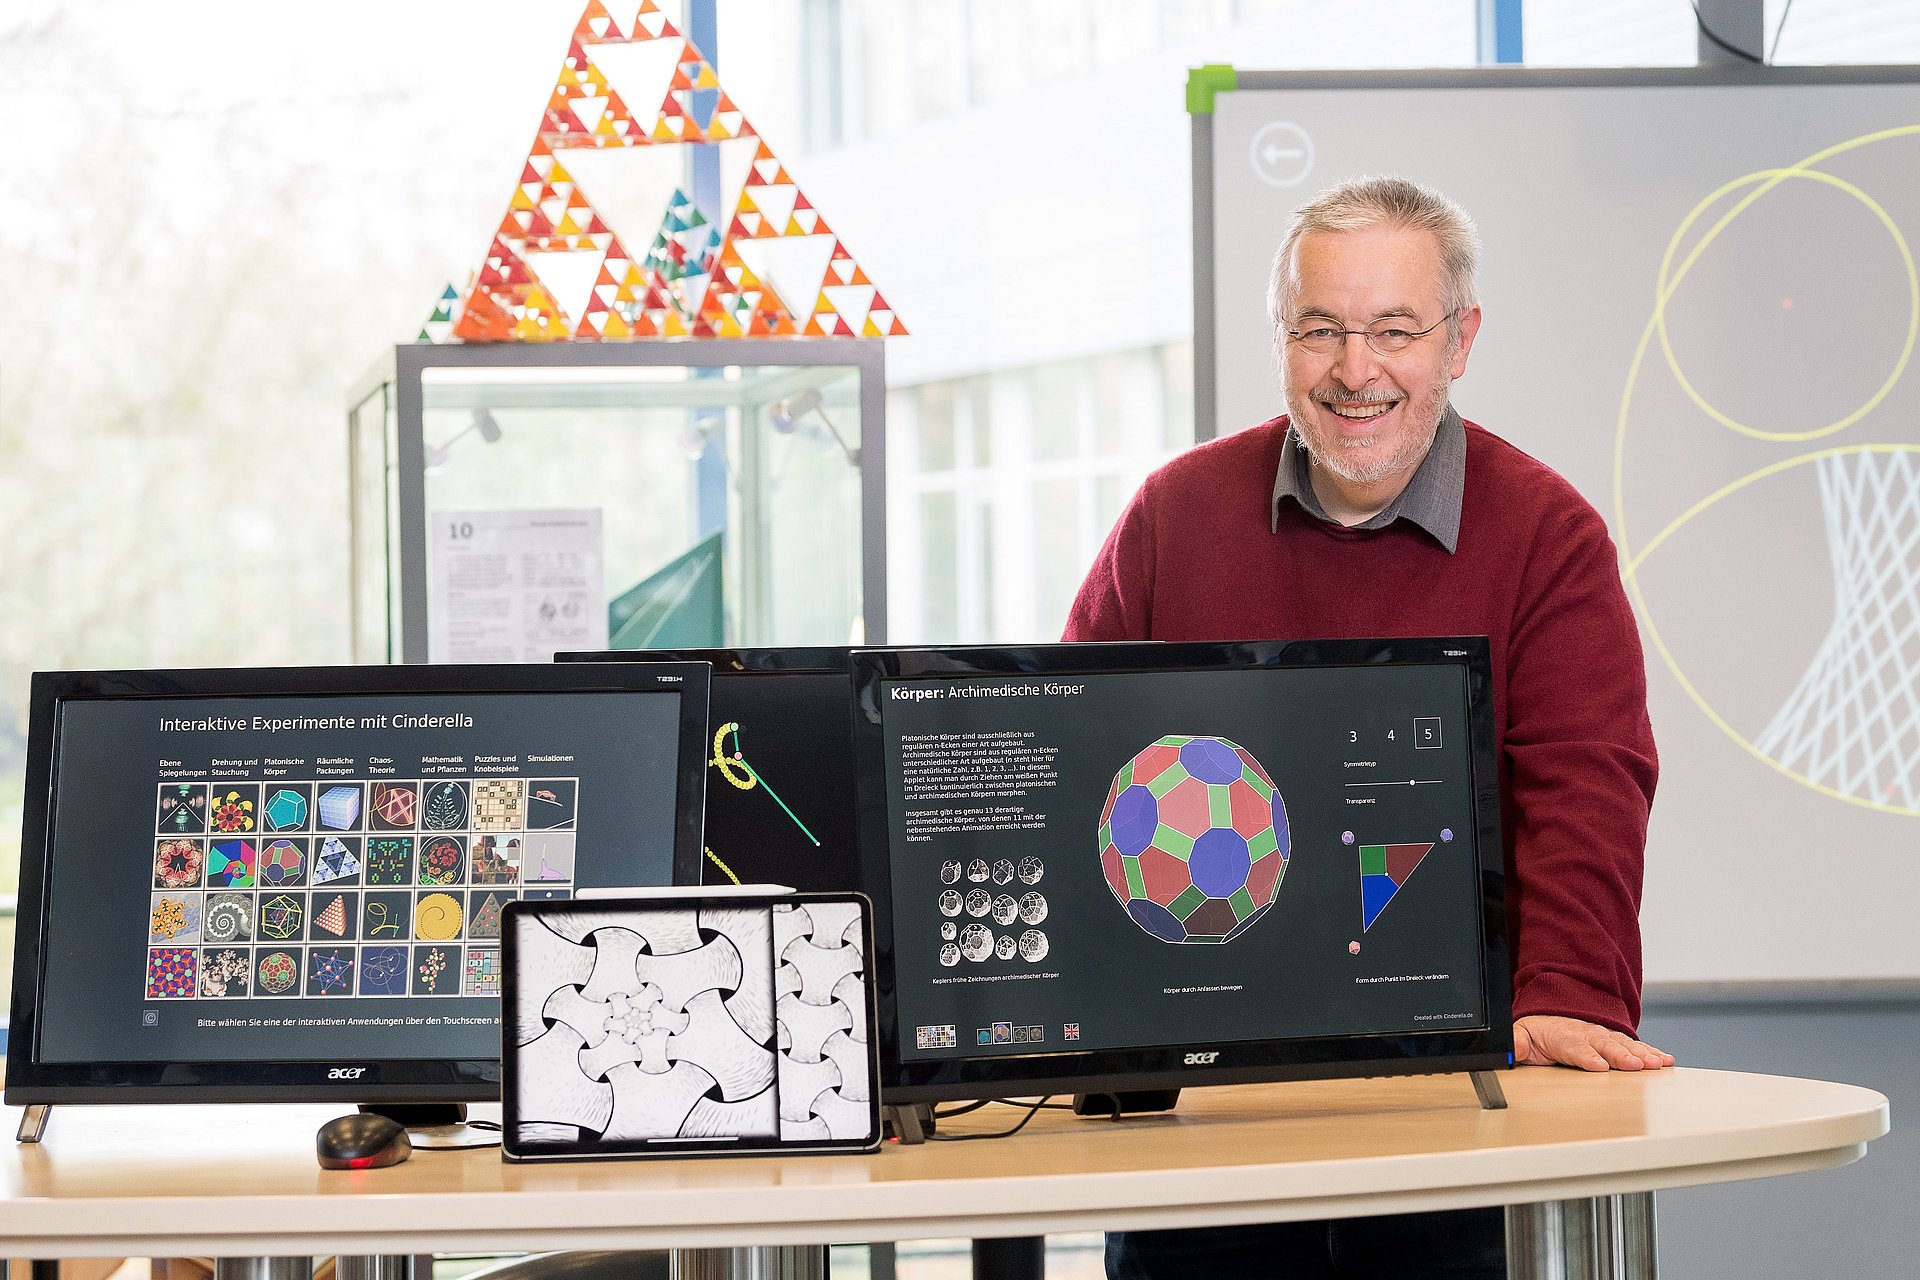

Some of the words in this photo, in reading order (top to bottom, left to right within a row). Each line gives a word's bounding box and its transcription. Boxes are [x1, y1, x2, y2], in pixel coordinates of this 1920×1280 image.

[450, 521, 473, 539] 10
[891, 687, 944, 702] Körper:
[948, 684, 1040, 698] Archimedische
[1044, 682, 1085, 697] Körper
[160, 716, 247, 731] Interaktive
[252, 715, 355, 733] Experimente
[361, 714, 387, 728] mit
[392, 713, 473, 728] Cinderella
[901, 733, 939, 741] Platonische
[939, 732, 961, 742] Körper
[962, 732, 976, 740] sind
[977, 730, 1022, 739] ausschließlich
[1350, 731, 1357, 743] 3
[1387, 729, 1395, 741] 4
[1425, 729, 1432, 740] 5
[902, 741, 933, 752] regulären
[934, 740, 961, 749] n-Ecken
[961, 740, 978, 748] einer
[979, 740, 990, 748] Art
[990, 739, 1025, 749] aufgebaut.
[902, 749, 950, 758] Archimedische
[951, 749, 972, 758] Körper
[973, 748, 987, 756] sind
[1001, 747, 1032, 757] regulären
[1033, 746, 1059, 754] n-Ecken
[159, 759, 182, 767] Ebene
[212, 759, 242, 767] Drehung
[316, 757, 354, 765] Räumliche
[369, 756, 394, 764] Chaos-
[474, 755, 501, 763] Puzzles
[903, 757, 959, 766] unterschiedlicher
[960, 757, 970, 765] Art
[971, 756, 1004, 766] aufgebaut
[1013, 755, 1030, 763] steht
[1031, 755, 1044, 763] hier
[1045, 754, 1055, 762] für
[159, 769, 207, 778] Spiegelungen
[211, 769, 249, 777] Stauchung
[264, 768, 287, 776] Körper
[316, 767, 354, 775] Packungen
[474, 765, 519, 773] Knobelspiele
[919, 767, 951, 775] natürliche
[953, 766, 970, 774] Zahl,
[1027, 763, 1050, 771] diesem
[904, 775, 926, 785] Applet
[926, 774, 943, 782] kann
[960, 773, 979, 781] durch
[980, 772, 1003, 781] Ziehen
[1015, 771, 1038, 780] weißen
[1039, 771, 1058, 779] Punkt
[904, 783, 913, 792] im
[913, 783, 939, 791] Dreieck
[940, 781, 984, 790] kontinuierlich
[985, 780, 1014, 789] zwischen
[1016, 779, 1056, 790] platonischen
[904, 792, 917, 800] und
[918, 790, 970, 799] archimedischen
[970, 789, 996, 799] Körpern
[997, 788, 1027, 798] morphen.
[905, 808, 939, 818] Insgesamt
[939, 807, 953, 817] gibt
[963, 808, 983, 817] genau
[985, 806, 993, 814] 13
[994, 805, 1024, 816] derartige
[906, 816, 953, 825] archimedische
[954, 815, 977, 825] Körper,
[991, 814, 1012, 822] denen
[1023, 813, 1034, 821] mit
[1034, 813, 1046, 821] der
[906, 824, 961, 833] nebenstehenden
[961, 823, 995, 832] Animation
[995, 822, 1021, 830] erreicht
[1021, 821, 1046, 829] werden
[968, 975, 1001, 983] Zeichnungen
[1042, 972, 1059, 980] Körper
[1370, 975, 1384, 983] durch
[1385, 974, 1399, 982] Punkt
[1399, 974, 1405, 982] im
[1406, 973, 1424, 981] Dreieck
[1425, 972, 1449, 980] verändern
[1220, 984, 1243, 992] bewegen
[198, 1019, 216, 1027] Bitte
[218, 1019, 246, 1027] wählen
[249, 1018, 261, 1026] Sie
[263, 1018, 280, 1026] eine
[283, 1018, 296, 1026] der
[298, 1017, 345, 1026] interaktiven
[347, 1017, 403, 1027] Anwendungen
[405, 1017, 424, 1025] über
[426, 1016, 441, 1025] den
[443, 1016, 492, 1025] Touchscreen
[1184, 1051, 1219, 1065] acer
[327, 1067, 366, 1079] acer
